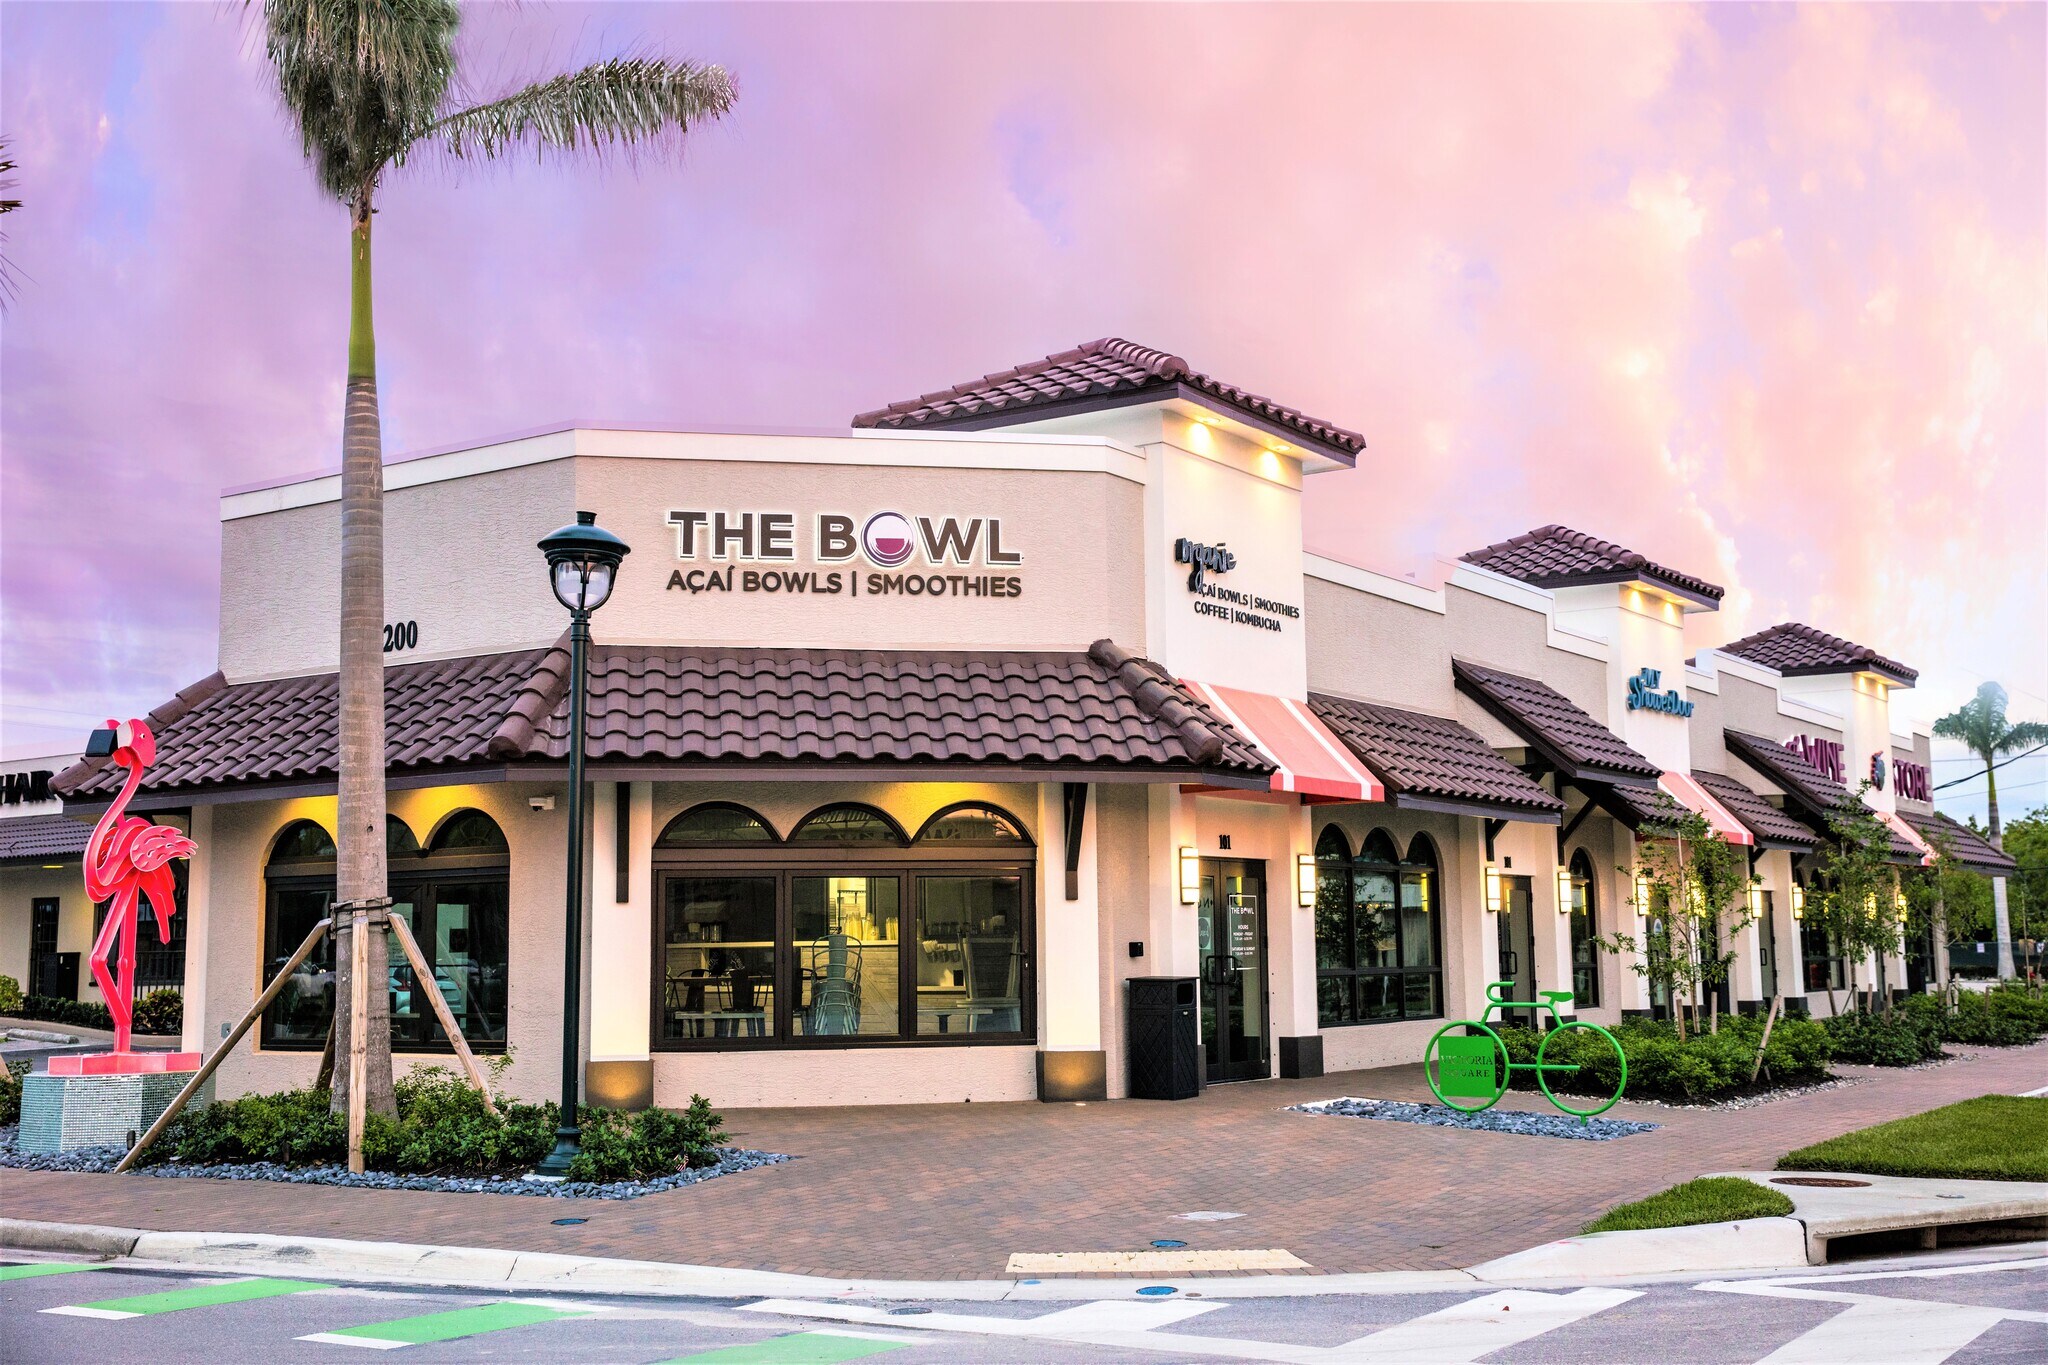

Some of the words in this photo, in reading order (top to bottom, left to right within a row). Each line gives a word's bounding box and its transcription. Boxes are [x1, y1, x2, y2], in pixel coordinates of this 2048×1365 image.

[667, 510, 795, 561] THE
[817, 509, 1024, 567] BOWL
[666, 566, 736, 595] AÇAÍ
[743, 571, 842, 594] BOWLS
[867, 573, 1022, 597] SMOOTHIES
[1194, 601, 1229, 620] COFFEE
[1235, 611, 1282, 632] KOMBUCHA
[1195, 583, 1216, 598] ÇAÍ
[1217, 587, 1249, 606] BOWLS
[1254, 597, 1300, 619] SMOOTHIES
[383, 620, 418, 652] 200
[1801, 735, 1847, 784] WINE
[1219, 835, 1231, 850] 101
[1231, 907, 1240, 915] THE
[1441, 1055, 1493, 1065] VICTORIA
